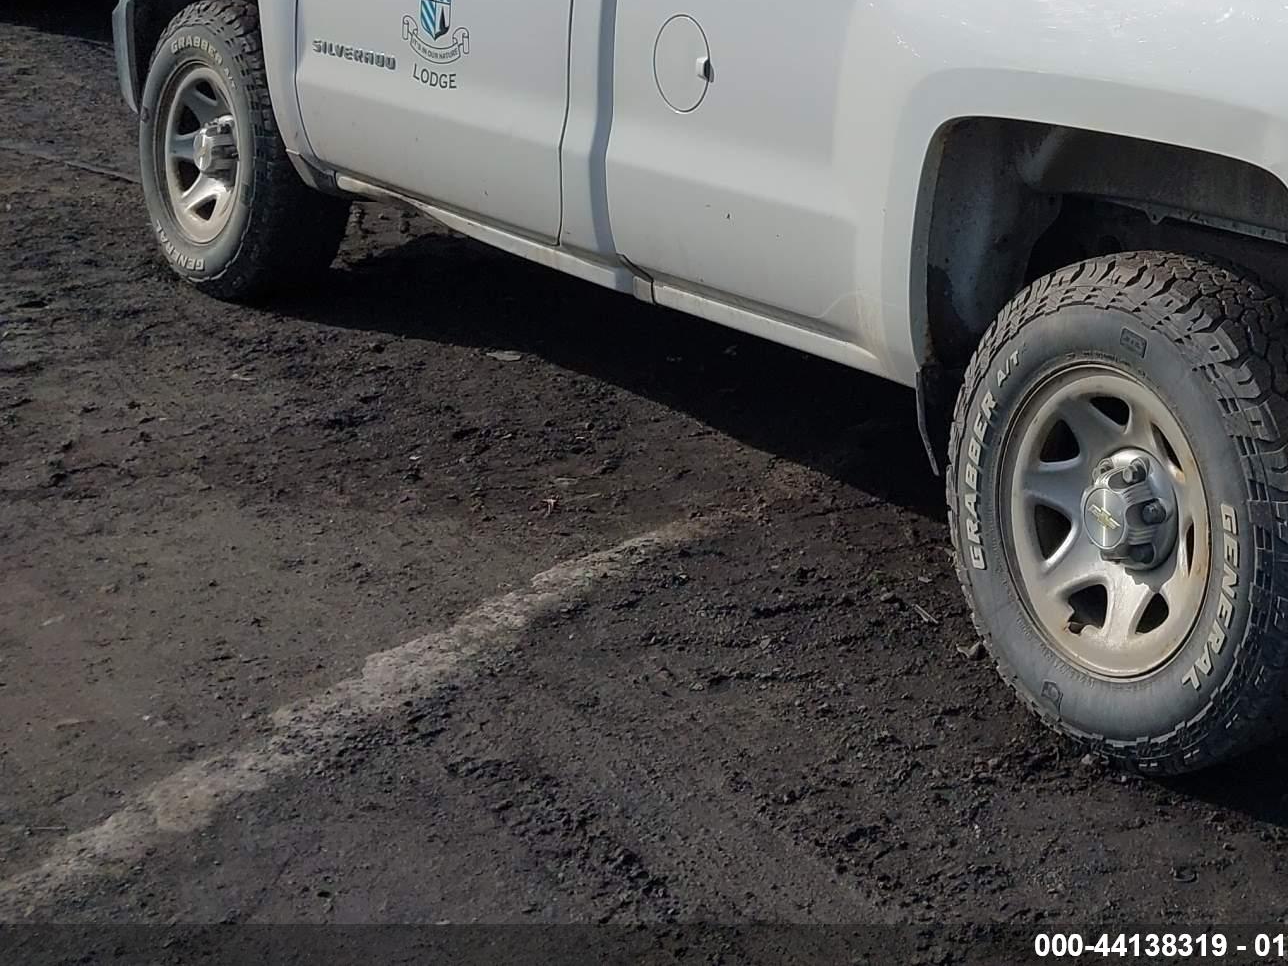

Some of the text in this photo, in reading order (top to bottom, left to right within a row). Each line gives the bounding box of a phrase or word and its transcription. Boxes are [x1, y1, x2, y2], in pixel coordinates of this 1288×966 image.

[171, 35, 224, 66] GRABBER
[312, 39, 397, 71] SILVERADO
[438, 47, 458, 59] NATURE
[412, 63, 457, 89] LODGE
[156, 219, 205, 272] GENERAL
[964, 390, 999, 571] GRABBER
[1181, 503, 1240, 691] GENERAL
